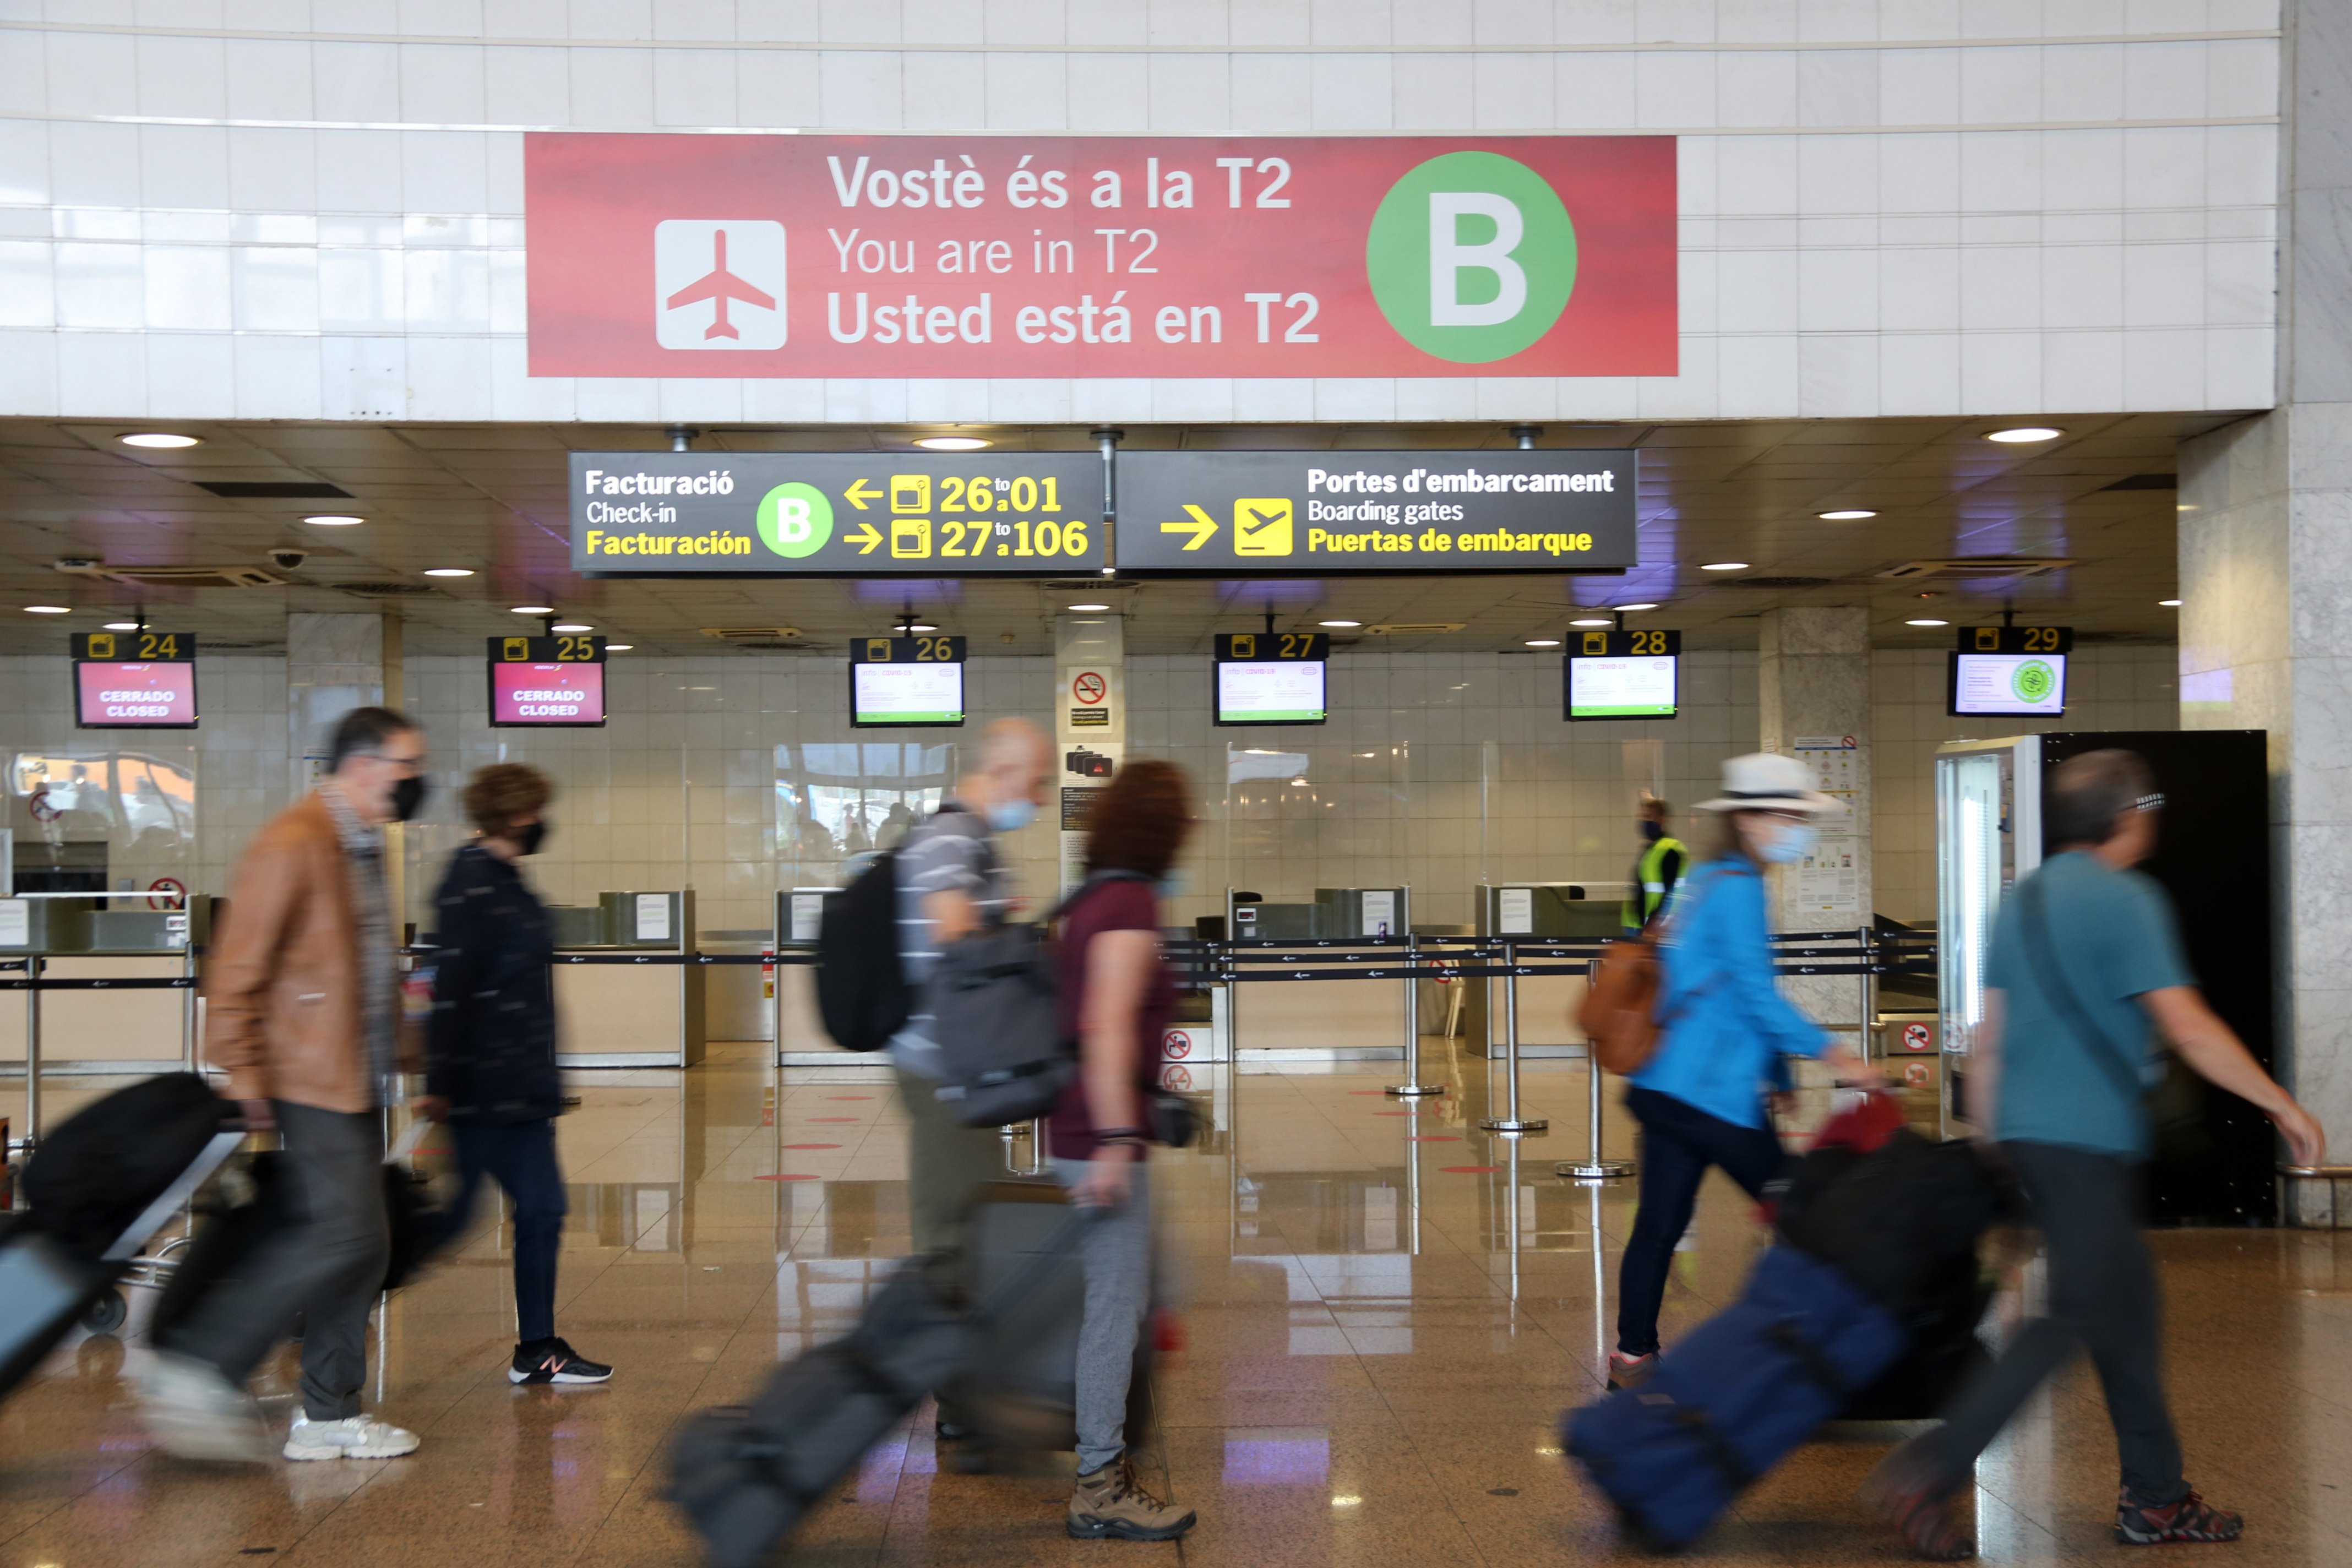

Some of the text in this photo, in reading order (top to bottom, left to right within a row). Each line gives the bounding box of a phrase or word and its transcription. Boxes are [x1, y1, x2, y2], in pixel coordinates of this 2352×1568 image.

[826, 154, 1292, 209] Vostè és a la T2
[827, 227, 1159, 274] You are in T2
[1428, 192, 1528, 327] B
[827, 290, 1320, 344] Usted está en T2
[585, 470, 734, 496] Facturació
[1308, 468, 1614, 493] Portes d'embarcament
[940, 476, 1062, 512] 26 to a 01
[586, 500, 677, 524] Check-in
[776, 497, 812, 543] B
[1308, 500, 1464, 526] Boarding gates
[586, 530, 752, 555] Facturación
[940, 520, 1088, 557] 27 to a 106
[1308, 528, 1592, 557] Puertas de embarque
[139, 634, 178, 658] 24
[557, 636, 595, 660] 25
[916, 637, 952, 661] 26
[1279, 634, 1315, 657] 27
[1630, 631, 1667, 654] 28
[2023, 628, 2059, 651] 29
[99, 691, 175, 702] CERRADO
[513, 690, 585, 701] CERRADO
[106, 706, 170, 717] CLOSED
[519, 705, 579, 716] CLOSED
